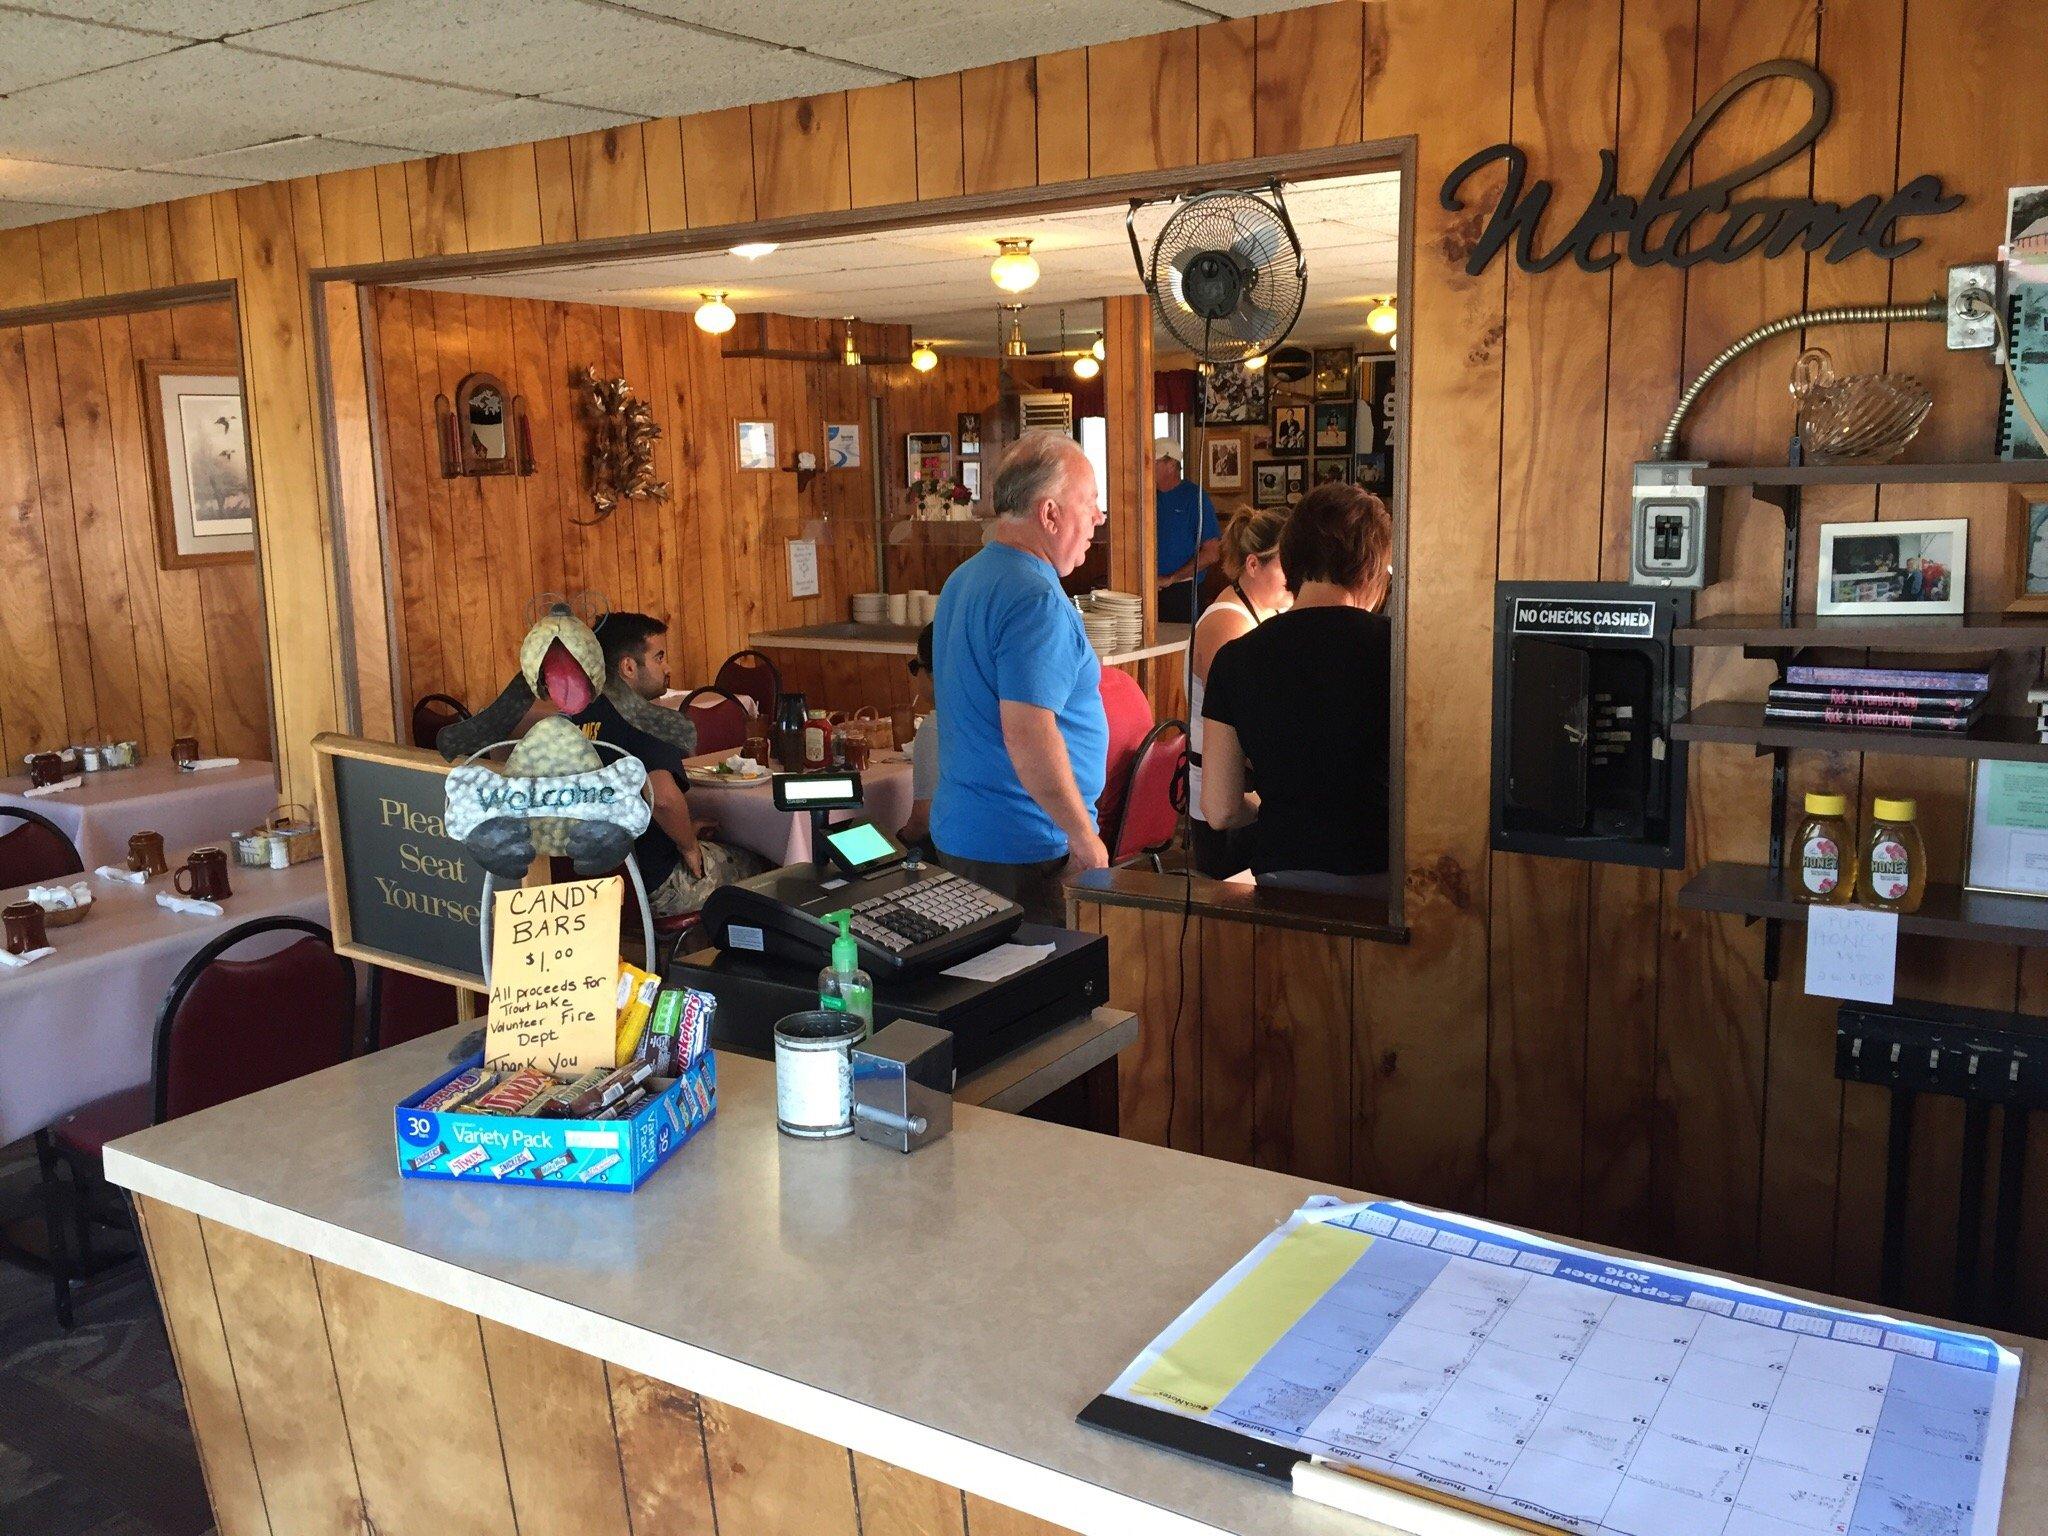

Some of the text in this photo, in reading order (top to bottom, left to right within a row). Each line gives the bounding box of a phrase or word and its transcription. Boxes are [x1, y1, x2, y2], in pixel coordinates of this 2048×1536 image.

[1439, 58, 1966, 277] Welcome
[1518, 608, 1650, 627] NO CHECKS CASHED
[1831, 689, 1849, 705] Ride
[1852, 690, 1859, 704] A
[1825, 709, 1843, 724] Ride
[1846, 710, 1853, 723] A
[1857, 710, 1889, 726] Painted
[476, 784, 616, 812] Welcome
[379, 797, 449, 838] Plea
[399, 843, 468, 884] Seat
[1803, 857, 1838, 870] HONEY
[1871, 861, 1908, 874] HONEY
[374, 876, 482, 927] Yourse
[509, 880, 604, 915] CANDY
[512, 914, 586, 945] BARS
[490, 976, 607, 1003] All proceeds for
[500, 1002, 531, 1016] Trout
[490, 1008, 596, 1034] Volunteer Fire
[518, 1030, 560, 1048] Dept
[548, 1052, 578, 1073] You
[407, 1116, 431, 1137] 30
[452, 1123, 555, 1153] Variety Pack
[640, 1122, 649, 1161] Pack
[646, 1110, 656, 1163] Variety
[659, 1127, 669, 1152] 30
[1604, 1266, 1651, 1284] 2016
[1559, 1267, 1685, 1303] September
[1582, 1318, 1598, 1326] 29
[1470, 1331, 1486, 1339] 23
[1356, 1347, 1370, 1356] 17
[1559, 1353, 1576, 1362] 22
[1443, 1367, 1457, 1375] 16
[1768, 1362, 1784, 1371] 27
[1654, 1376, 1670, 1384] 21
[1868, 1384, 1885, 1393] 26
[1535, 1394, 1550, 1402] 15
[1752, 1402, 1769, 1410] 20
[1973, 1408, 1990, 1416] 25
[1420, 1410, 1429, 1418] 9
[1633, 1417, 1647, 1425] 14
[1231, 1420, 1277, 1437] Saturday
[1296, 1426, 1304, 1435] 3
[1856, 1427, 1872, 1436] 19
[1516, 1438, 1525, 1446] 8
[1328, 1446, 1362, 1461] Friday
[1388, 1451, 1397, 1460] 2
[1735, 1445, 1751, 1454] 13
[1964, 1453, 1981, 1462] 18
[1617, 1464, 1625, 1472] 7
[1416, 1472, 1467, 1493] Thursday
[1842, 1473, 1859, 1482] 12
[1511, 1499, 1579, 1526] Wednesday
[1957, 1502, 1974, 1511] 11
